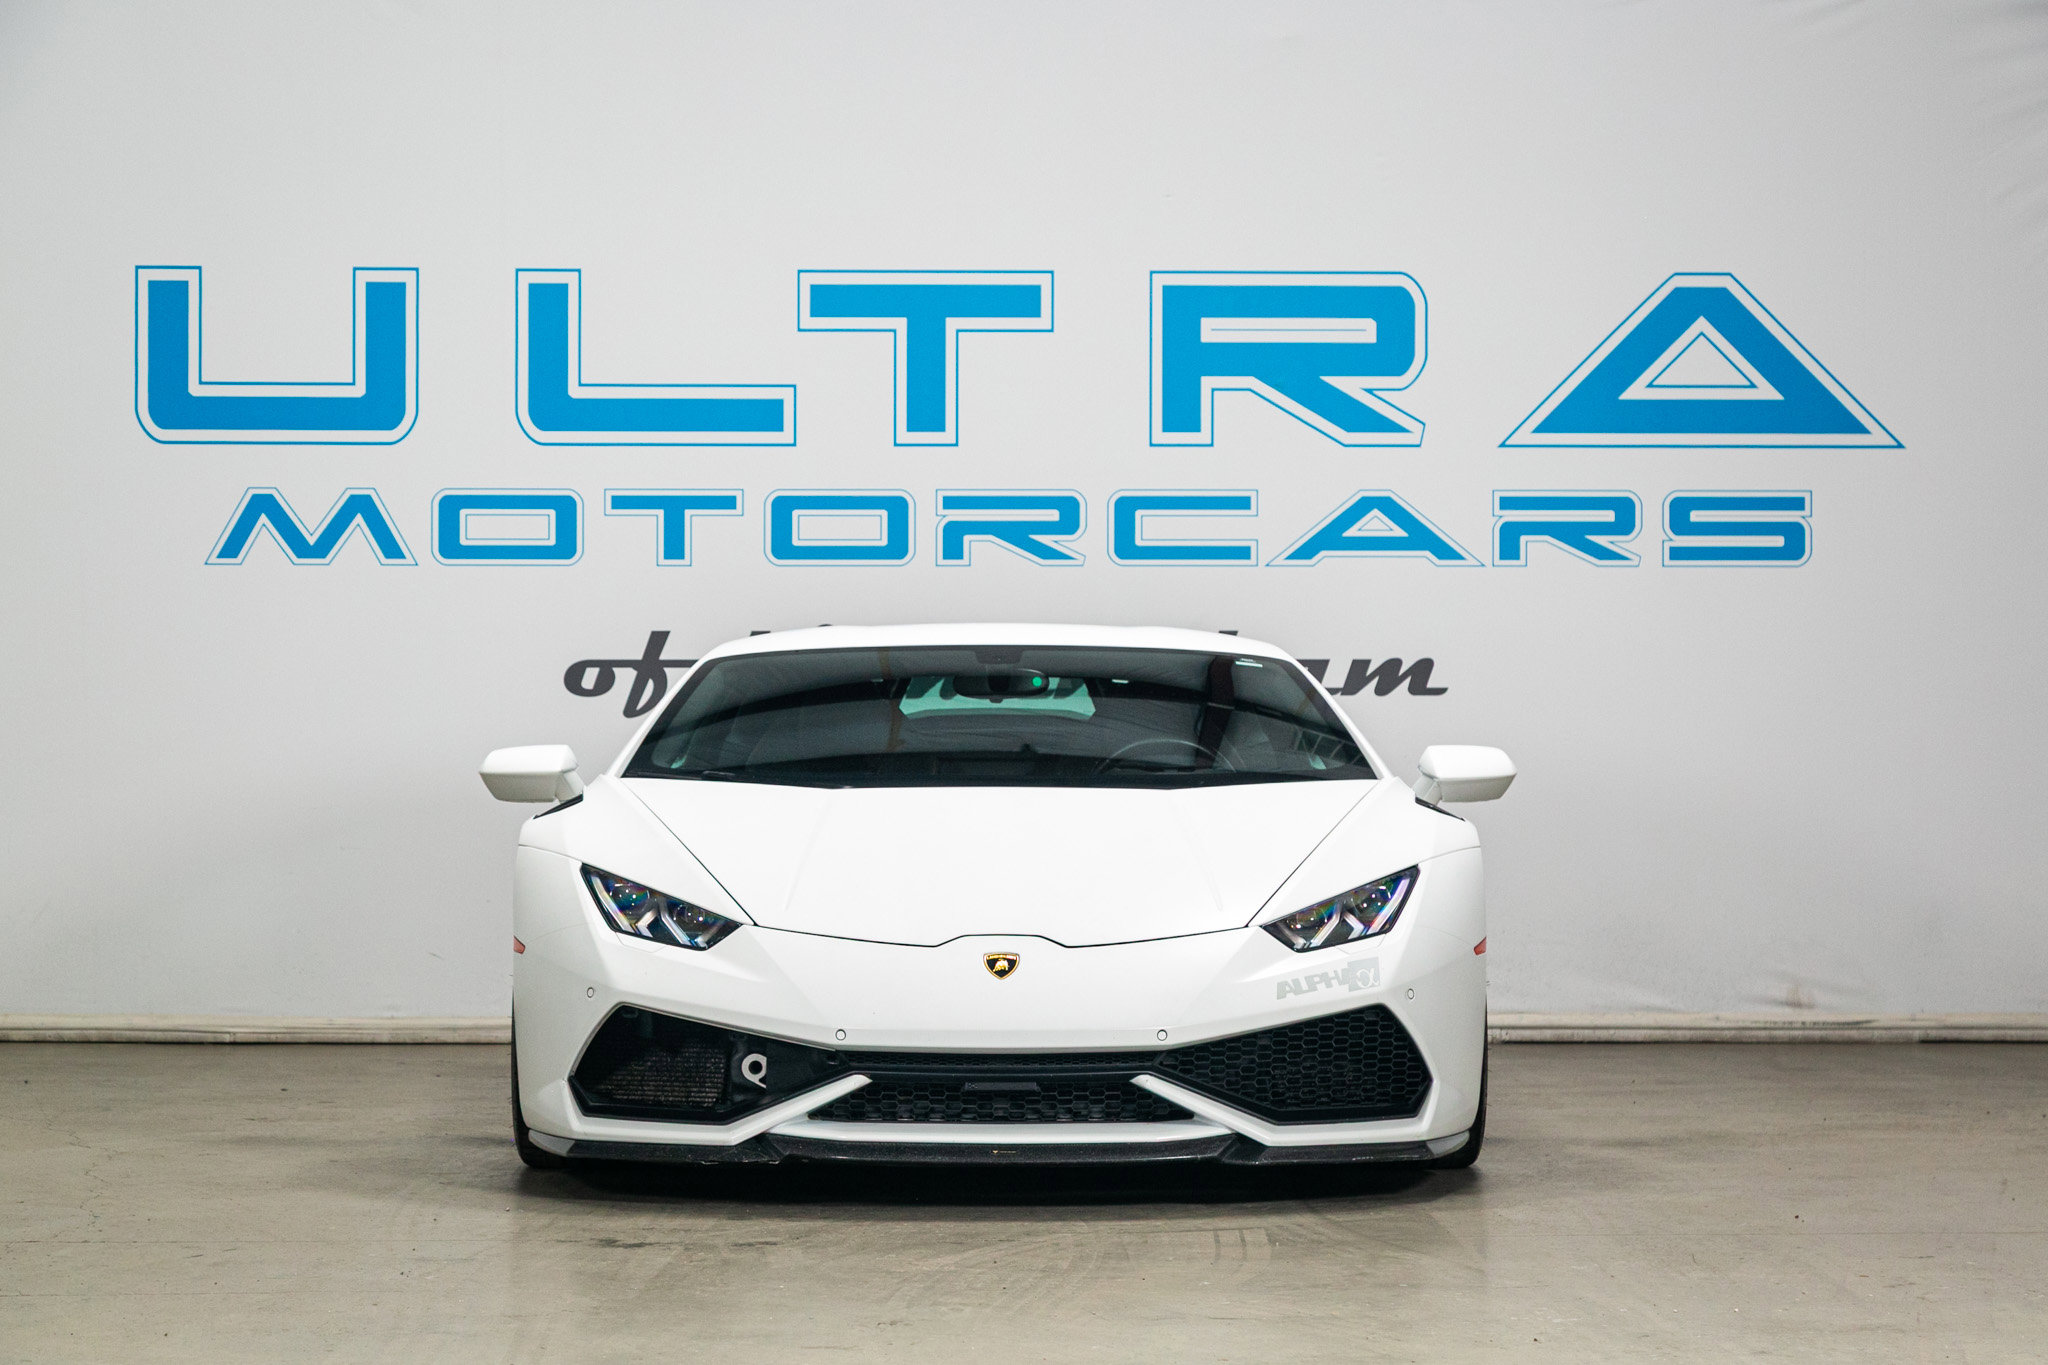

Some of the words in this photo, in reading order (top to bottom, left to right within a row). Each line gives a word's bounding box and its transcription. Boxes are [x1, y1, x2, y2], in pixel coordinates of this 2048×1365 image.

[134, 265, 1906, 449] ULTRA
[204, 486, 1814, 567] MOTORCARS
[564, 630, 699, 719] of
